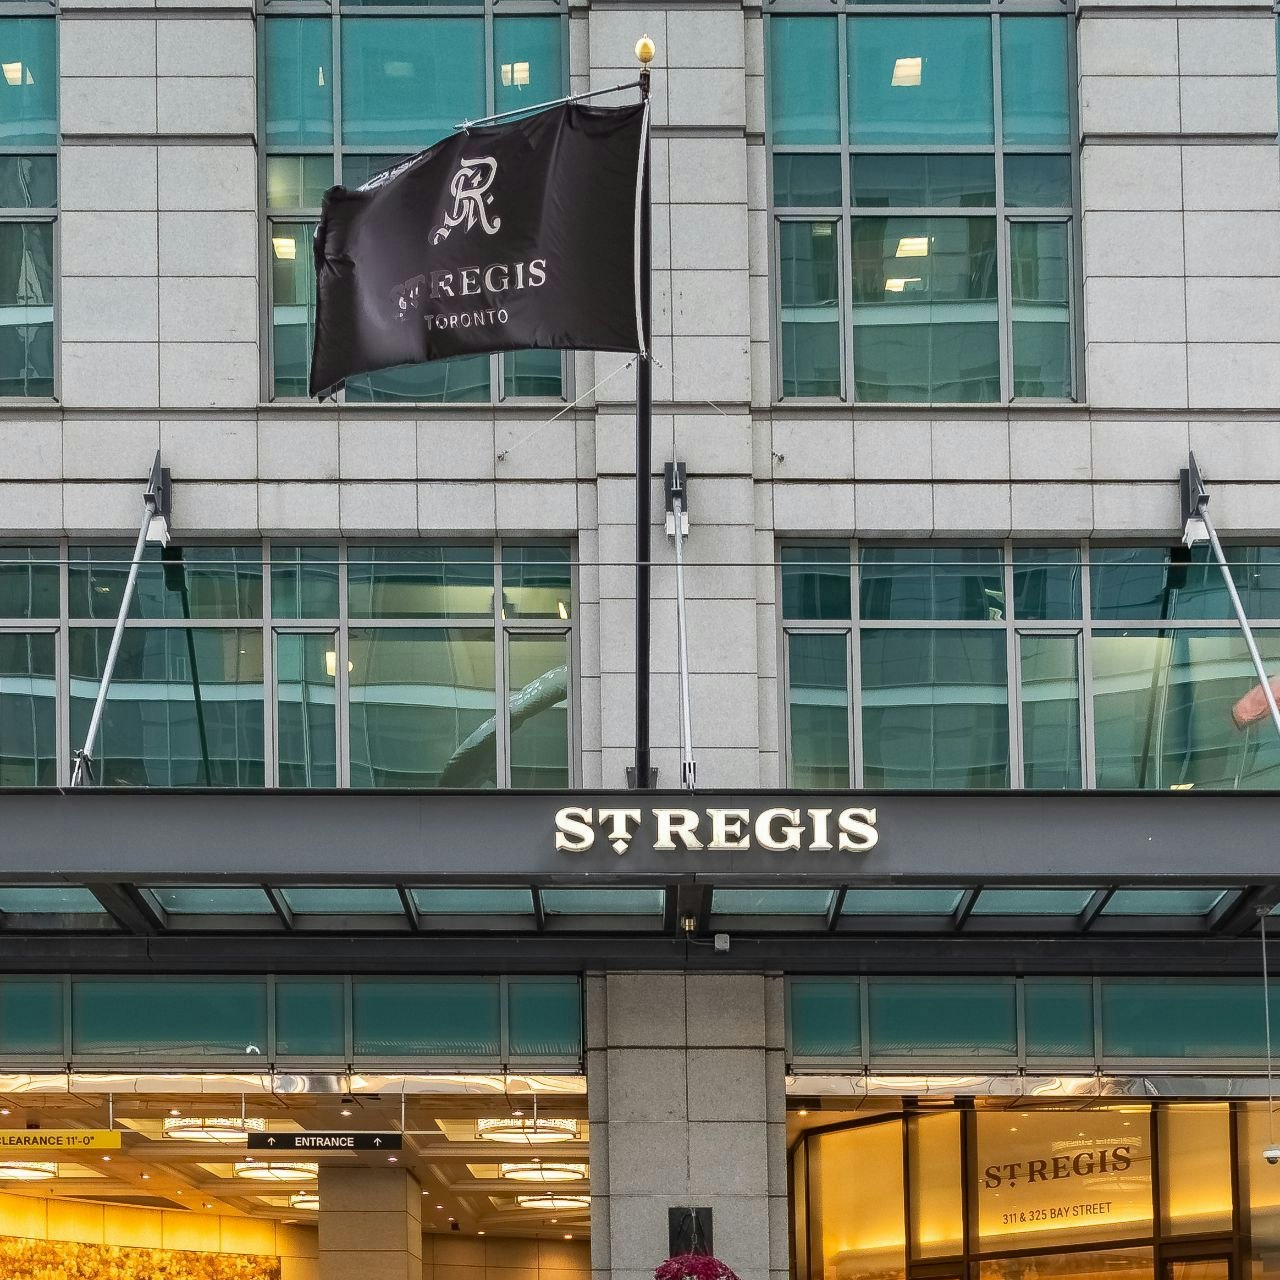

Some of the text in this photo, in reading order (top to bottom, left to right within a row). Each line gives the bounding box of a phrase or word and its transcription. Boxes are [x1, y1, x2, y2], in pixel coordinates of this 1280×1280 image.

[430, 259, 547, 299] REGIS
[424, 308, 509, 331] TORONTO
[652, 807, 879, 852] REGIS
[295, 1138, 355, 1147] ENTRANCE
[1027, 1146, 1131, 1183] REGIS
[1003, 1202, 1112, 1224] 311 & 325 BAY STREET
